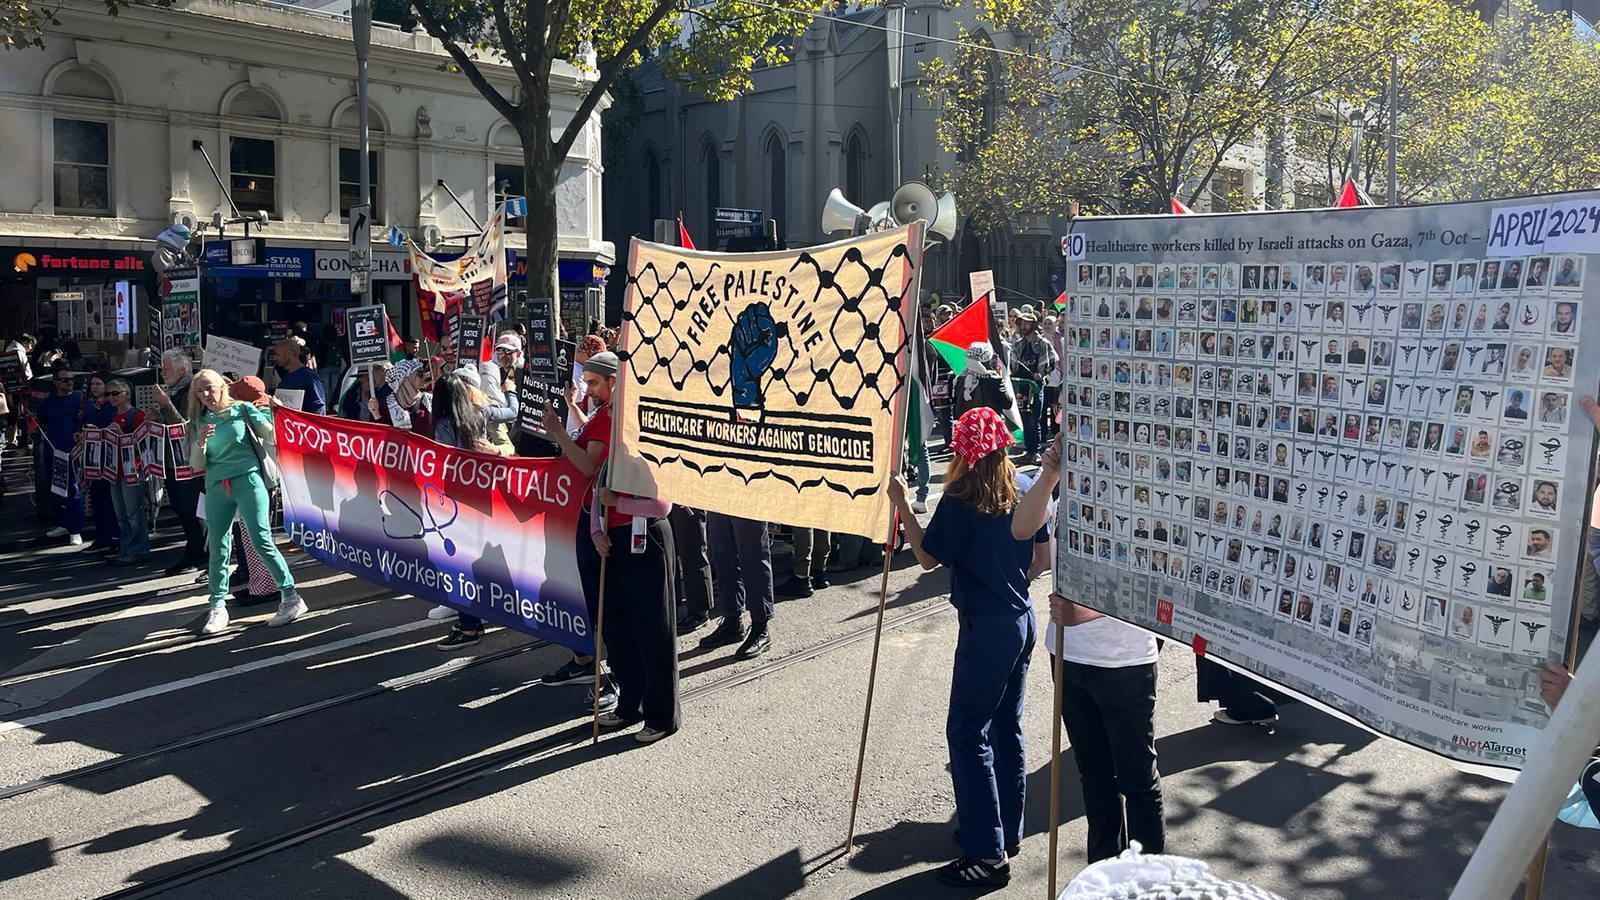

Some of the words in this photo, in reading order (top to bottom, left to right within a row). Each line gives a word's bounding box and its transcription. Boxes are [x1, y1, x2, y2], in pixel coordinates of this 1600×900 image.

[717, 209, 743, 217] Swanston
[1488, 208, 1548, 248] APRIL
[1547, 206, 1600, 238] 2024
[1086, 240, 1148, 252] Healthcare
[1152, 240, 1200, 252] workers
[1204, 238, 1236, 251] killed
[1238, 238, 1254, 254] by
[1257, 236, 1294, 250] Israeli
[1297, 236, 1344, 250] attacks
[1348, 237, 1366, 248] on
[1371, 232, 1412, 250] Gaza,
[1416, 230, 1436, 248] 7th
[1440, 229, 1468, 246] Oct
[41, 254, 110, 269] fortune
[351, 250, 366, 260] ONLY
[317, 258, 352, 271] GON
[372, 260, 400, 272] CHA
[686, 284, 721, 346] FREE
[724, 270, 824, 352] PALESTINE
[531, 320, 546, 328] JUSTICE
[535, 332, 544, 341] FOR
[216, 341, 228, 349] STOP
[232, 346, 242, 354] THE
[532, 357, 552, 366] HOSPITAL
[523, 375, 548, 391] Nurses
[550, 384, 565, 396] and
[552, 399, 559, 408] &
[641, 410, 703, 437] HEALTHCARE
[706, 420, 756, 446] WORKERS
[757, 426, 804, 451] AGAINST
[808, 434, 871, 460] GENOCIDE
[284, 418, 332, 452] STOP
[337, 434, 436, 476] BOMBING
[442, 454, 572, 506] HOSPITALS
[290, 522, 372, 568] Healthcare
[377, 549, 452, 593] Workers
[458, 572, 484, 602] for
[490, 582, 587, 637] Palestine
[1159, 601, 1172, 612] HW
[1161, 613, 1168, 622] W
[1182, 620, 1200, 630] healthcare
[1201, 626, 1217, 637] facilities
[1175, 609, 1196, 620] Healthcare
[1197, 617, 1212, 627] Workers
[1213, 623, 1226, 632] Watch
[1257, 640, 1276, 651] initiative
[1283, 650, 1302, 661] monitor
[1313, 662, 1332, 673] spotlight
[1341, 673, 1354, 683] Israeli
[1396, 699, 1419, 712] attacks
[1431, 709, 1469, 728] healthcare
[1472, 722, 1503, 734] workers
[1451, 734, 1526, 756] #NotATarget
